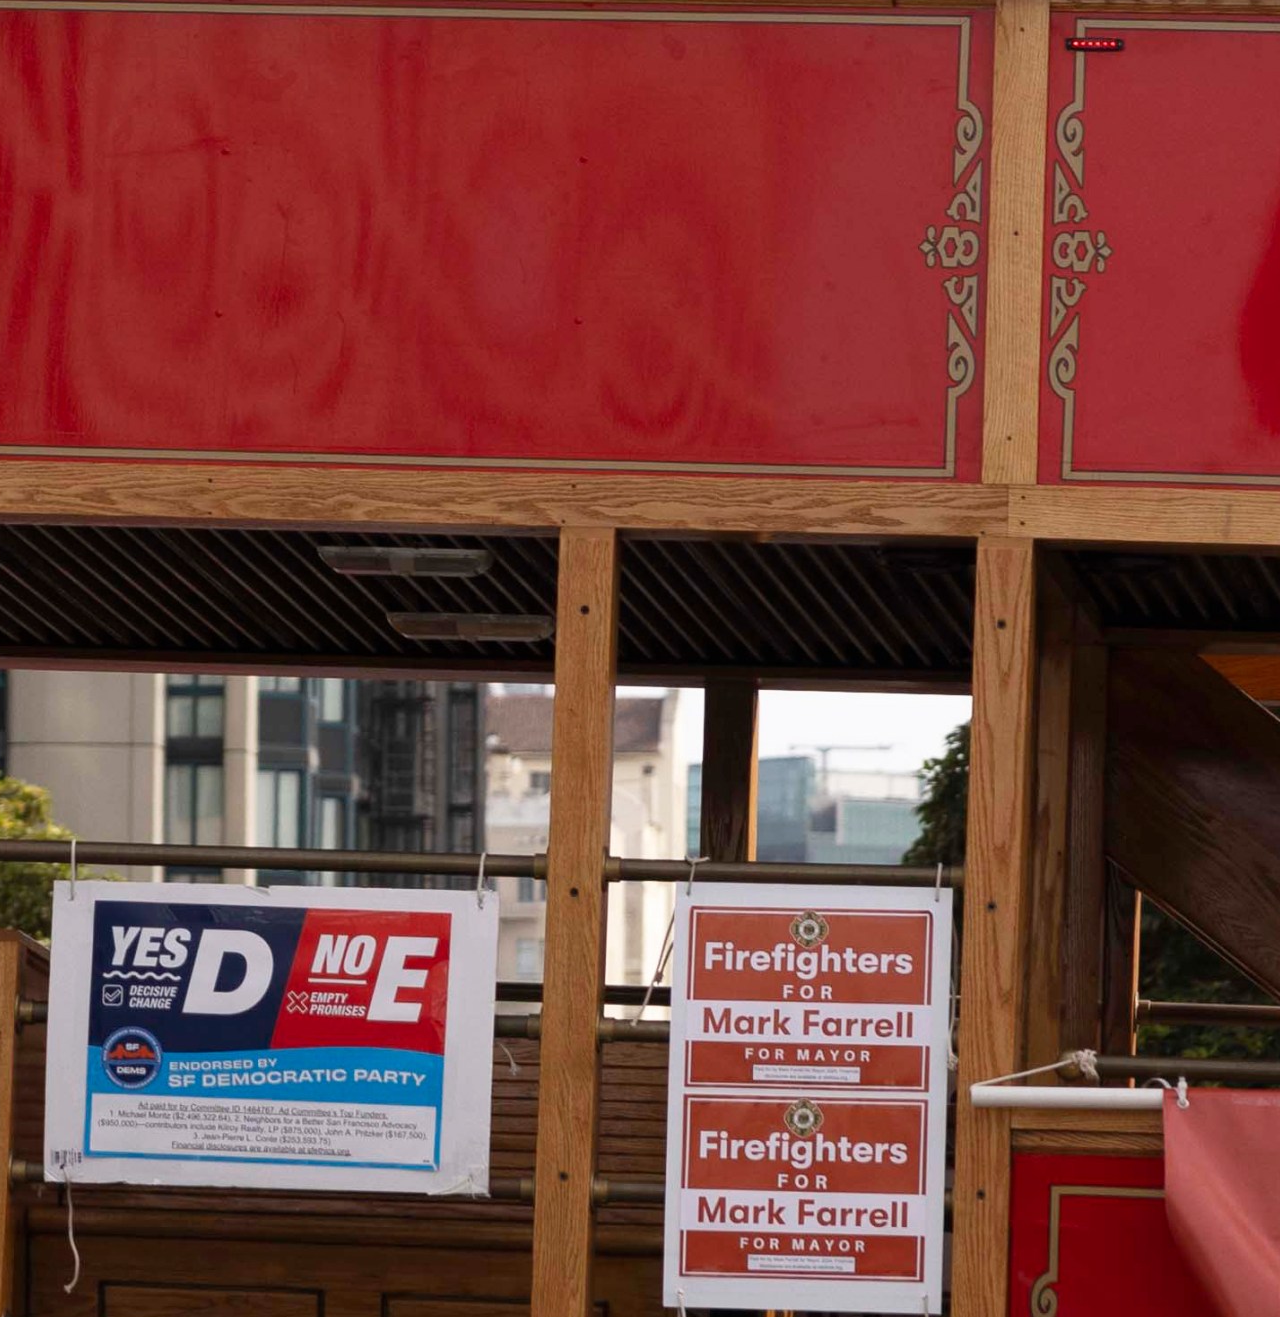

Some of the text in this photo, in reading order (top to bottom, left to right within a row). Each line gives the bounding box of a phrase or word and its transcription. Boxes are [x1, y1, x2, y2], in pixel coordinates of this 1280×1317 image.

[704, 941, 912, 979] Firefighters
[111, 926, 274, 1015] YES D
[311, 934, 438, 1022] NO E
[130, 985, 178, 998] DECISIVE
[310, 992, 348, 1004] EMPTY
[783, 984, 832, 999] FOR
[129, 997, 172, 1009] CHANGE
[310, 1004, 366, 1017] PROMISES
[702, 1007, 913, 1038] Mark Farrell
[125, 1043, 139, 1051] SF
[744, 1048, 870, 1063] FOR MAYOR
[116, 1066, 147, 1075] DEMS
[169, 1057, 277, 1072] ENDORSED BY
[168, 1074, 196, 1088] SF
[202, 1068, 347, 1088] DEMOCRATIC
[354, 1070, 426, 1086] PARTY
[698, 1130, 907, 1169] Firefighters
[777, 1173, 827, 1189] FOR
[697, 1196, 908, 1227] Mark Farrell
[739, 1237, 865, 1252] FOR MAYOR
